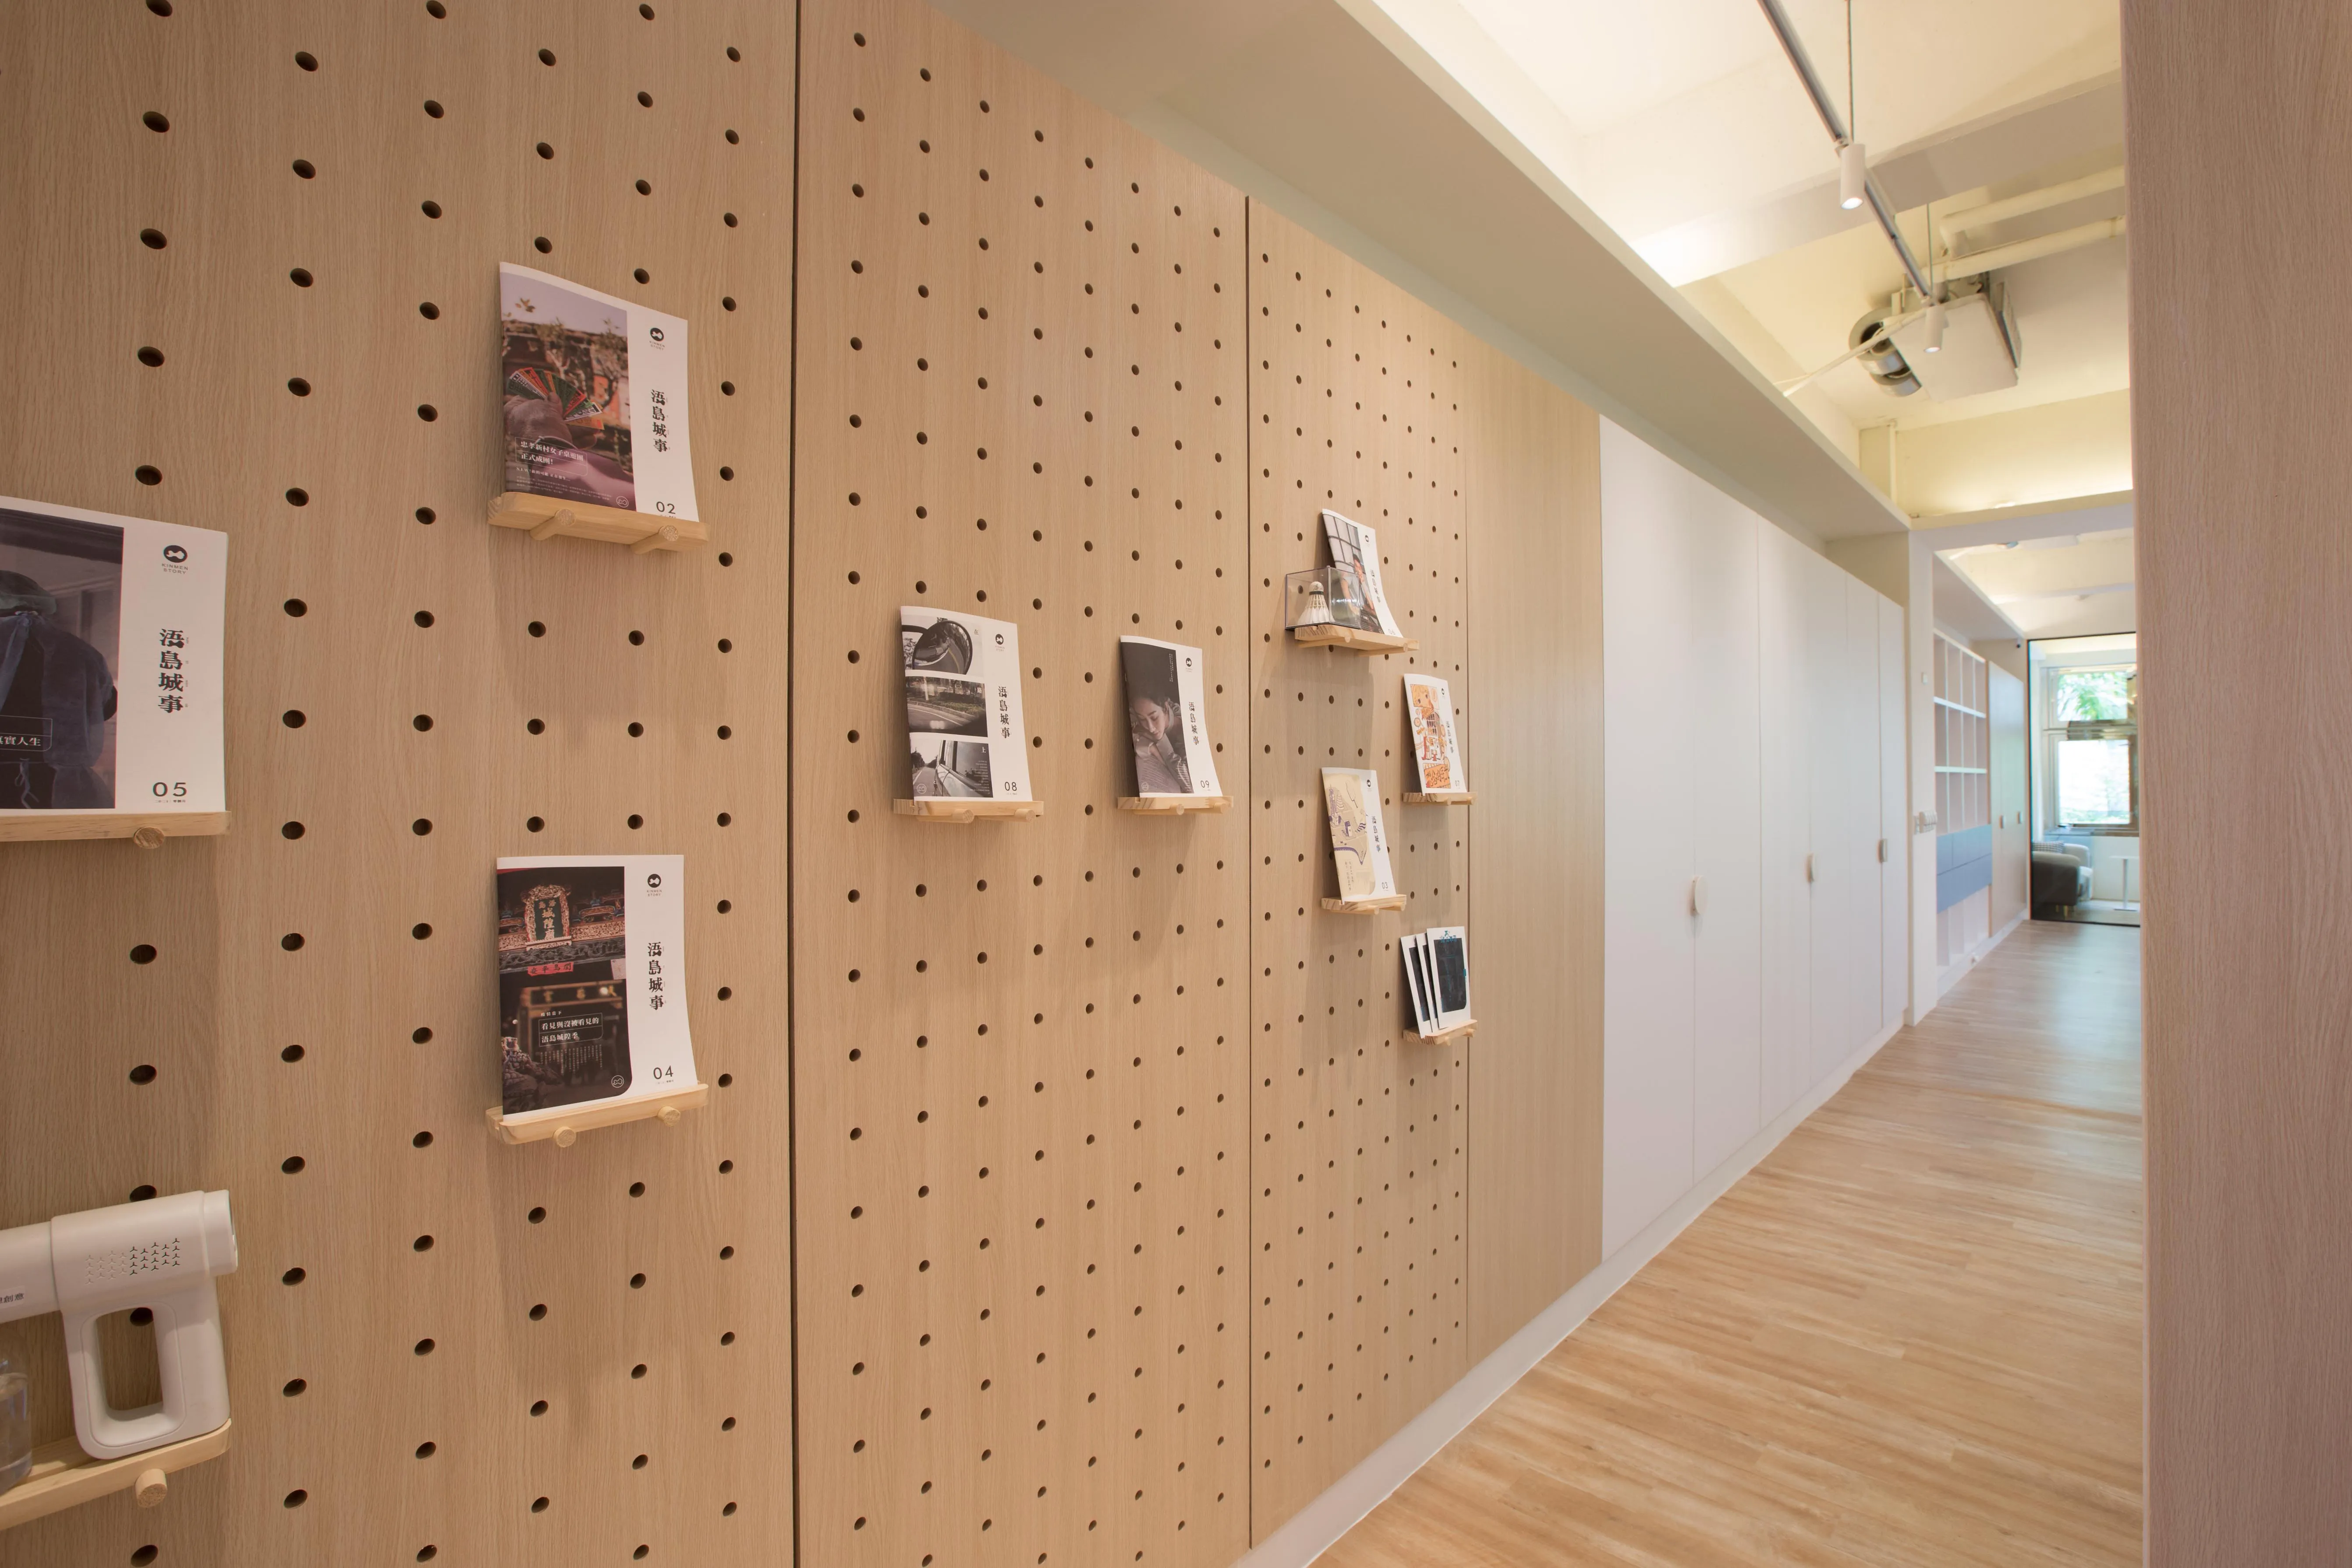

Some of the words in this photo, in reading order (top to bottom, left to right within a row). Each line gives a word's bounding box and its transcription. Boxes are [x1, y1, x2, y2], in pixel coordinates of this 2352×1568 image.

[651, 389, 668, 452] 浯島城事
[656, 502, 676, 514] 02
[158, 628, 184, 713] 浯島城事
[153, 782, 187, 796] 05
[1005, 782, 1017, 791] 08
[648, 942, 664, 1010] 浯島城事
[542, 1017, 599, 1030] 看見與沒被看見的
[542, 1032, 578, 1043] 浯島城隍季
[653, 1065, 673, 1080] 04
[0, 1293, 25, 1304] 創意
